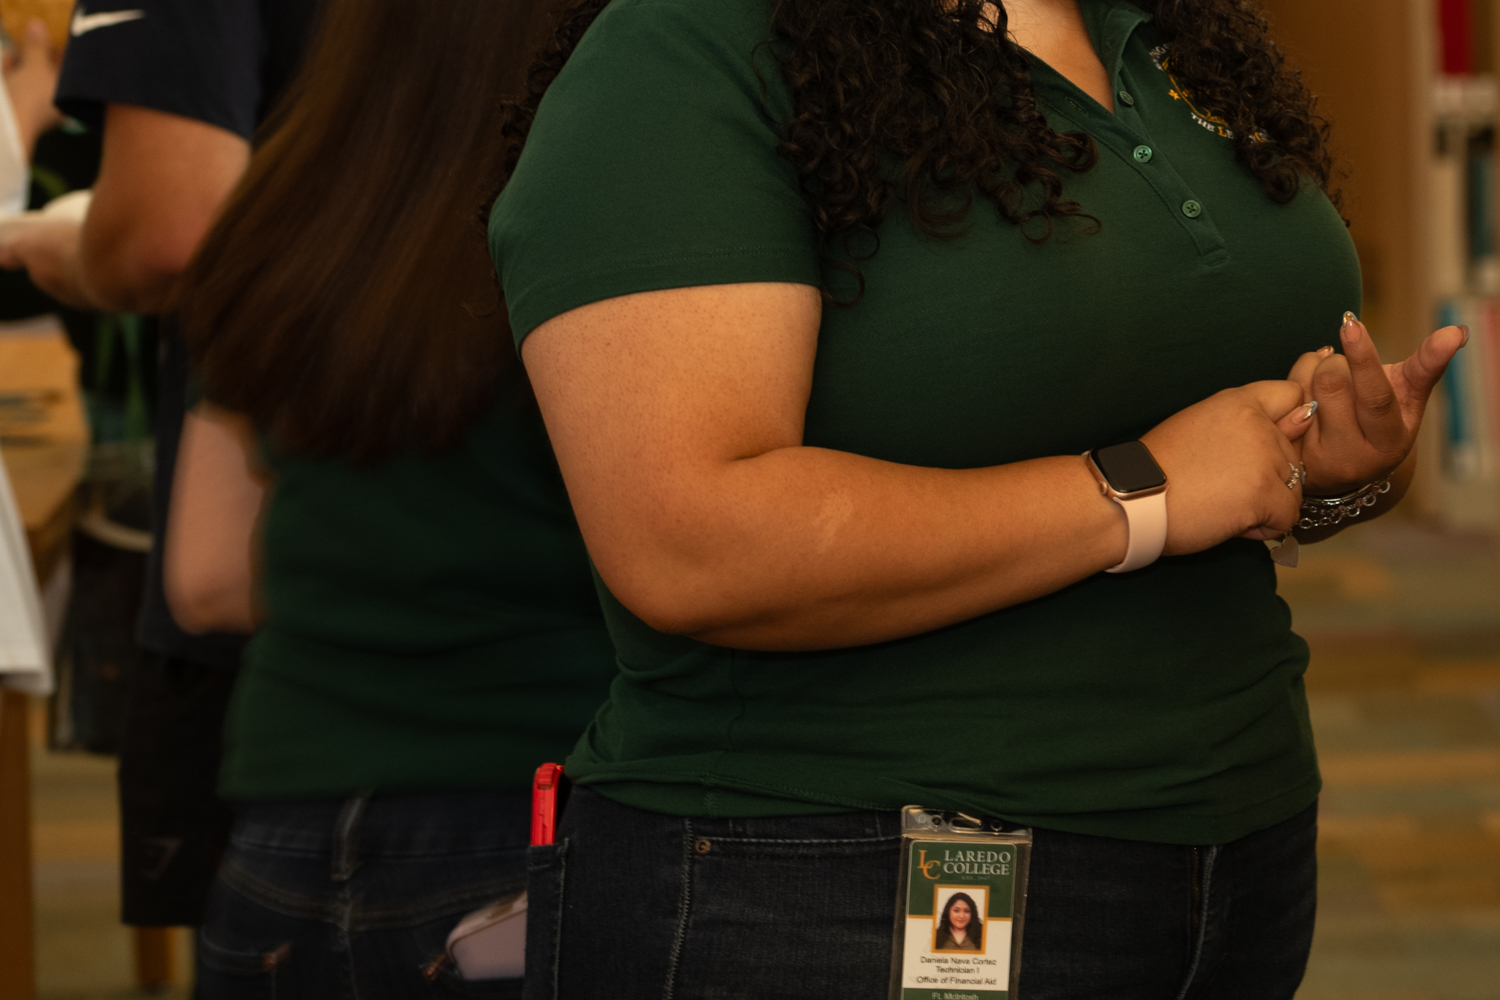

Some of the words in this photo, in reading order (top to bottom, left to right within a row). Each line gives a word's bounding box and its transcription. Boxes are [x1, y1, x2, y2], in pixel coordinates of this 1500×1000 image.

[1190, 112, 1216, 132] THE
[944, 850, 1011, 863] LAREDO
[943, 862, 1010, 875] COLLEGE
[921, 956, 949, 964] Daniela
[936, 966, 975, 974] Technician
[916, 976, 938, 984] Office
[949, 977, 983, 985] Financial
